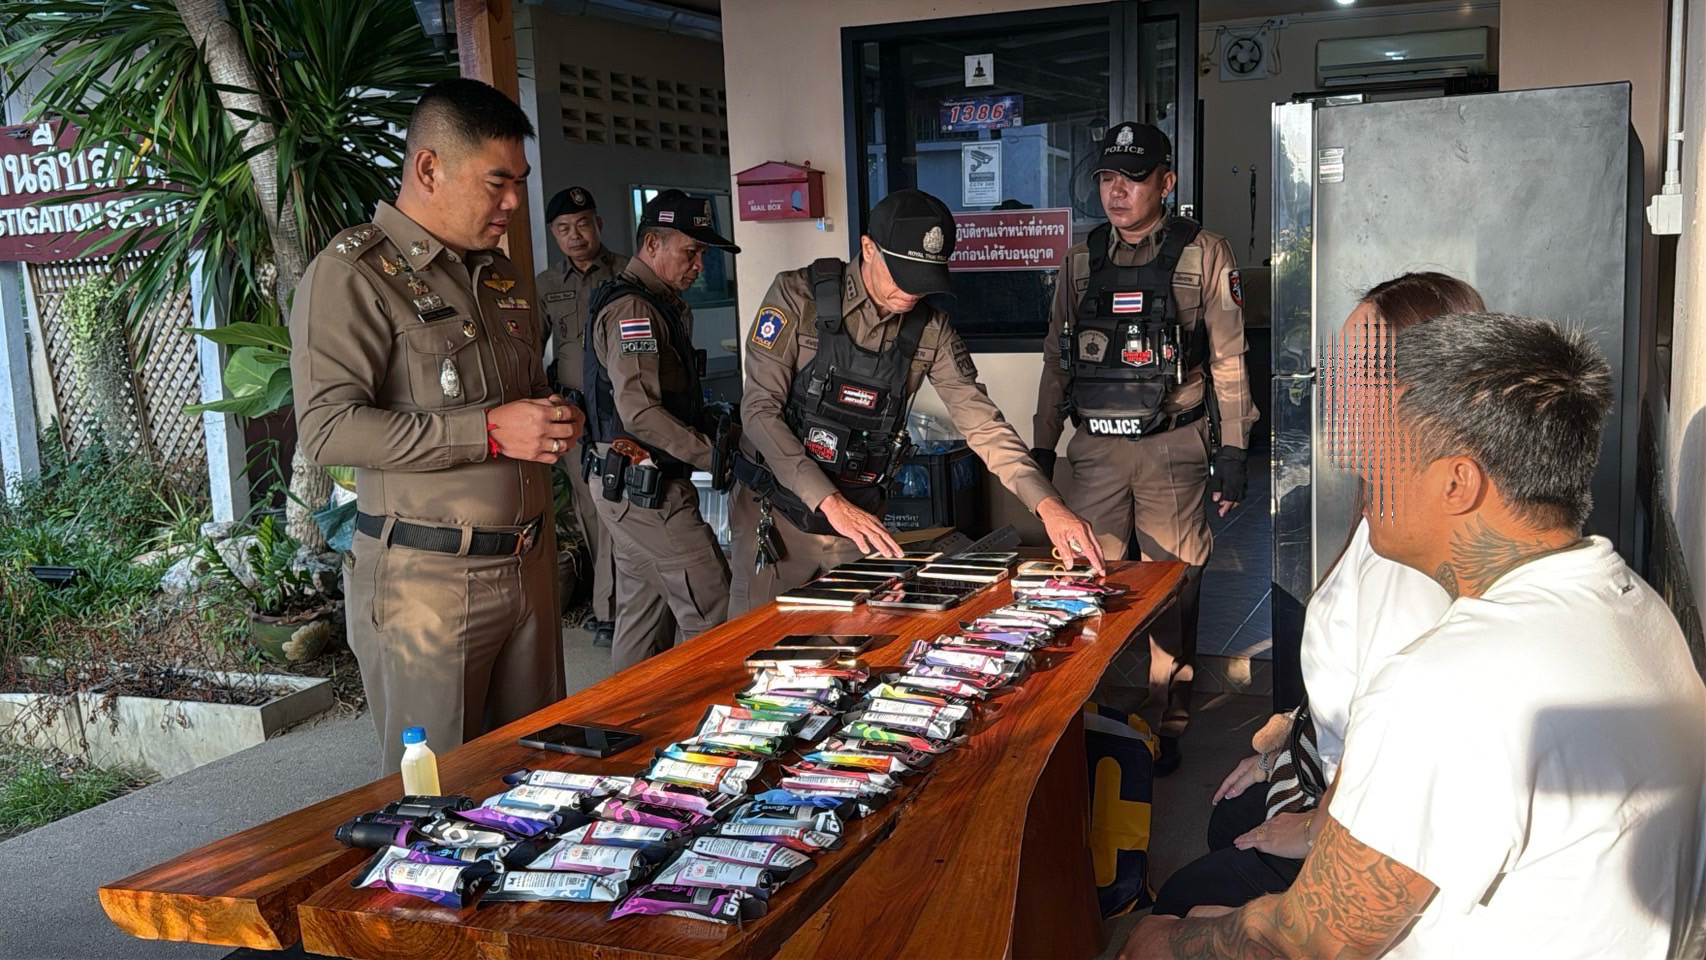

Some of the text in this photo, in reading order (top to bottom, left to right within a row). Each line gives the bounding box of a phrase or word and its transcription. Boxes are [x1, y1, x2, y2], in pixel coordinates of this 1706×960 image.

[950, 103, 1005, 124] 1386
[1104, 145, 1145, 155] POLICE
[750, 203, 782, 212] MAIL BOX
[907, 250, 925, 258] ROYAL
[622, 341, 656, 352] POLICE
[1089, 418, 1142, 435] POLICE
